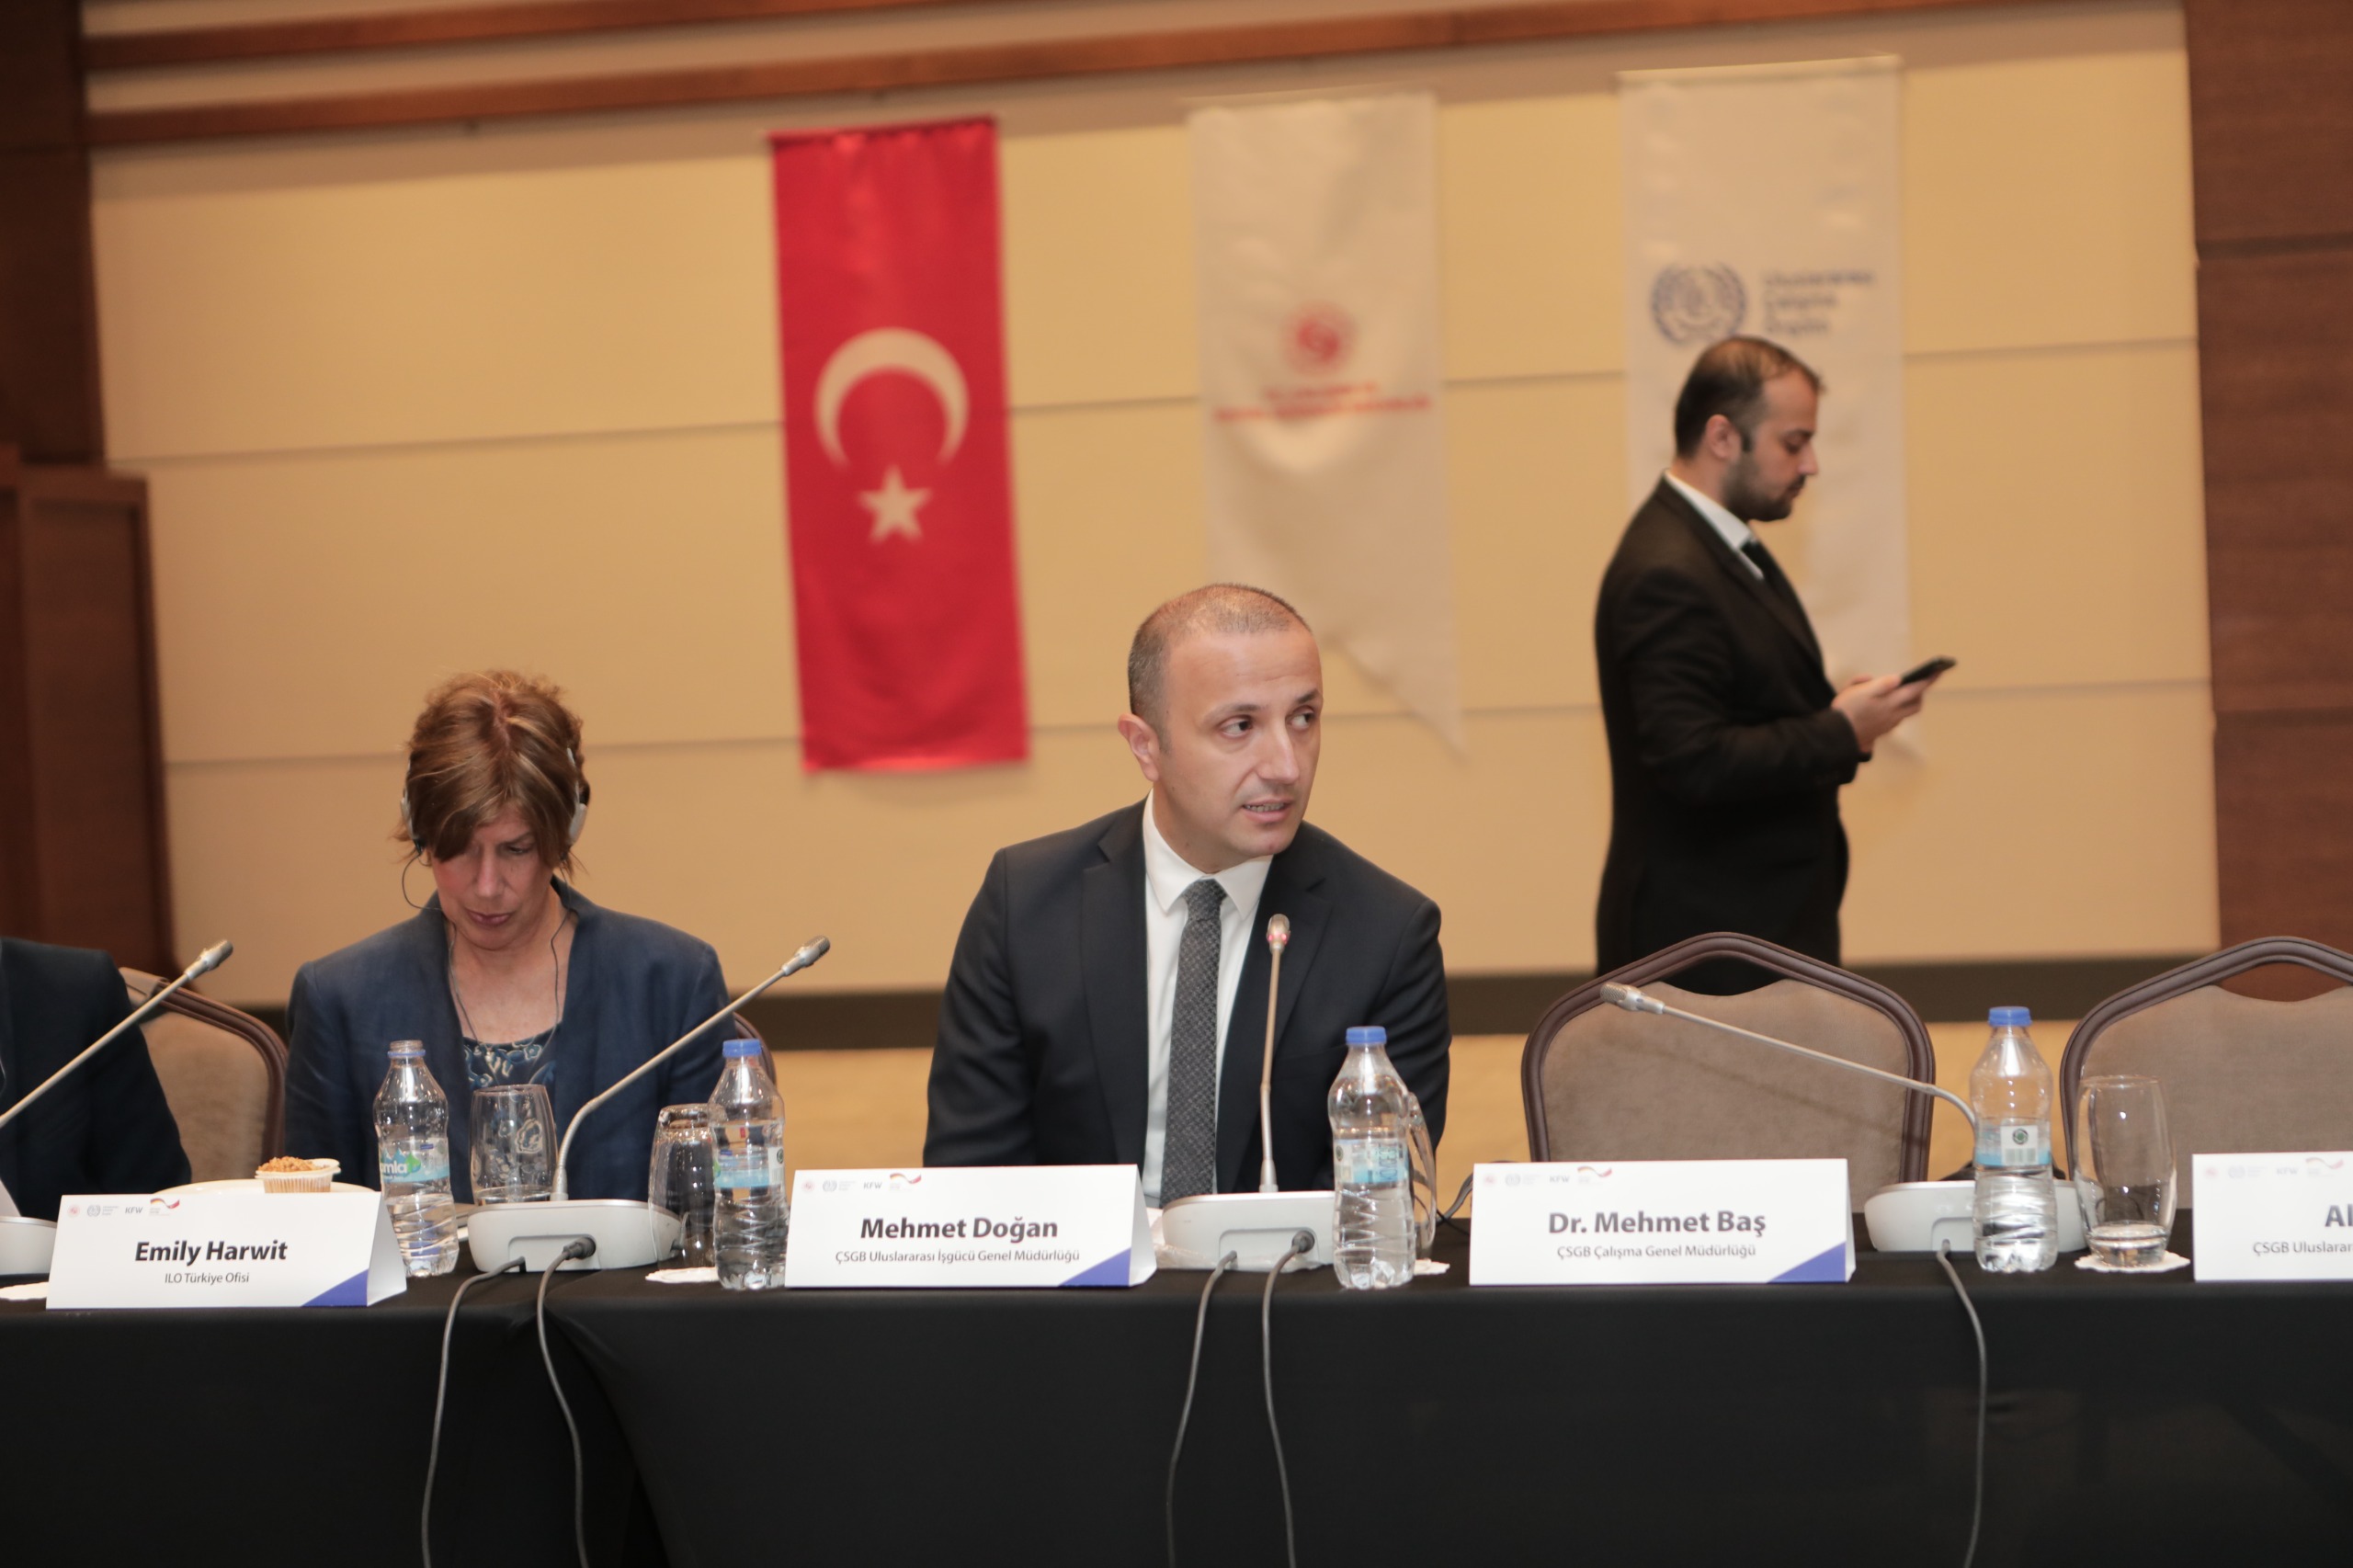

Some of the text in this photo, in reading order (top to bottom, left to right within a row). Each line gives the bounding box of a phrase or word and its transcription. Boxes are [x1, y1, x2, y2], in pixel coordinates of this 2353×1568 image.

[860, 1216, 1058, 1244] Mehmet Doğan
[1549, 1210, 1767, 1237] Dr. Mehmet Baş
[134, 1240, 288, 1267] Emily Harwit
[835, 1248, 1080, 1265] ÇSGB Uluslararası İşgücü Genel Müdürlüğü
[1557, 1244, 1756, 1260] ÇSGB Çalışma Genel Müdürlüğü
[2253, 1241, 2353, 1257] ÇSGB Uluslarar
[165, 1271, 249, 1287] ILO Türkiye Ofisi
